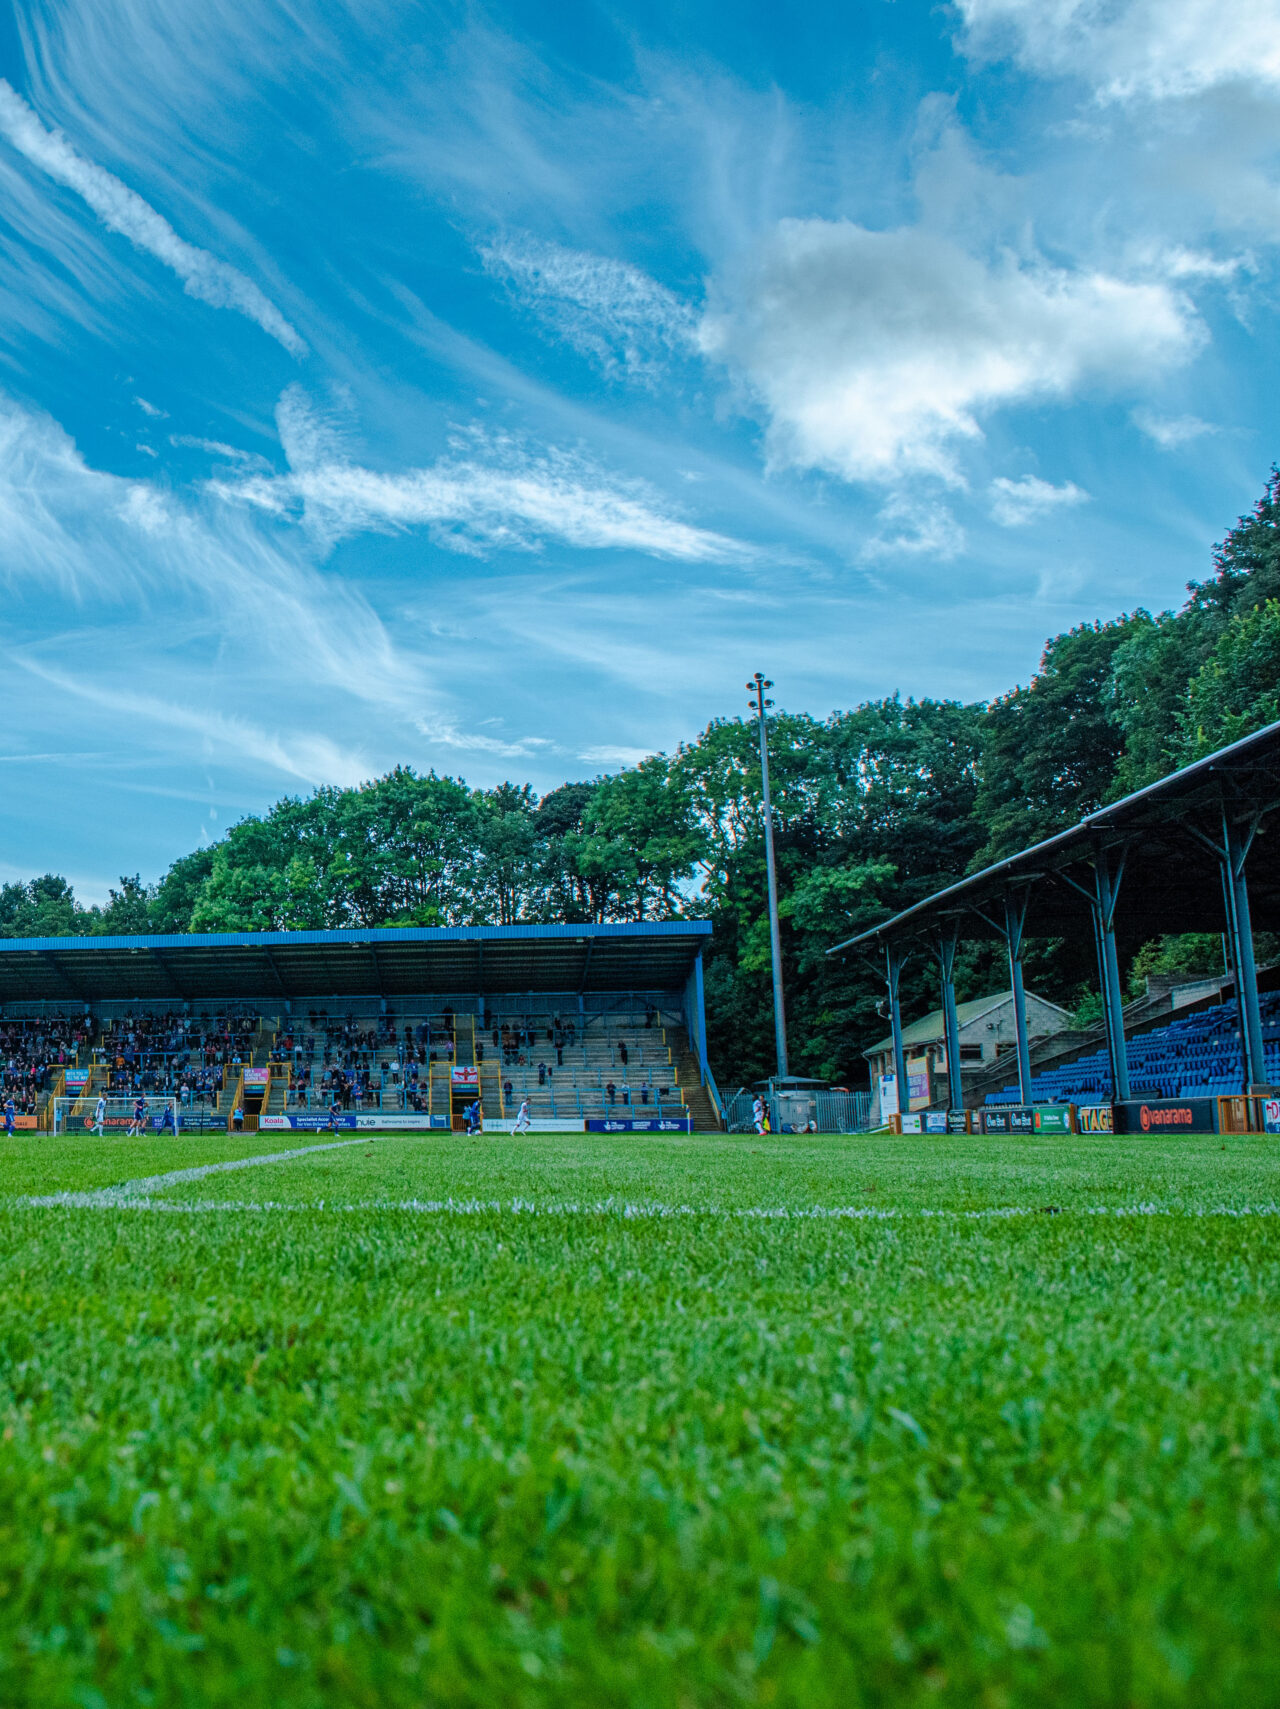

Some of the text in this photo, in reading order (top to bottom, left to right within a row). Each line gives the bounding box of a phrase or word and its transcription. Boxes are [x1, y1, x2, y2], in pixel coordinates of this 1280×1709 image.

[356, 1118, 376, 1126] nuie
[1081, 1109, 1108, 1131] TAG
[1150, 1107, 1193, 1124] vanarama
